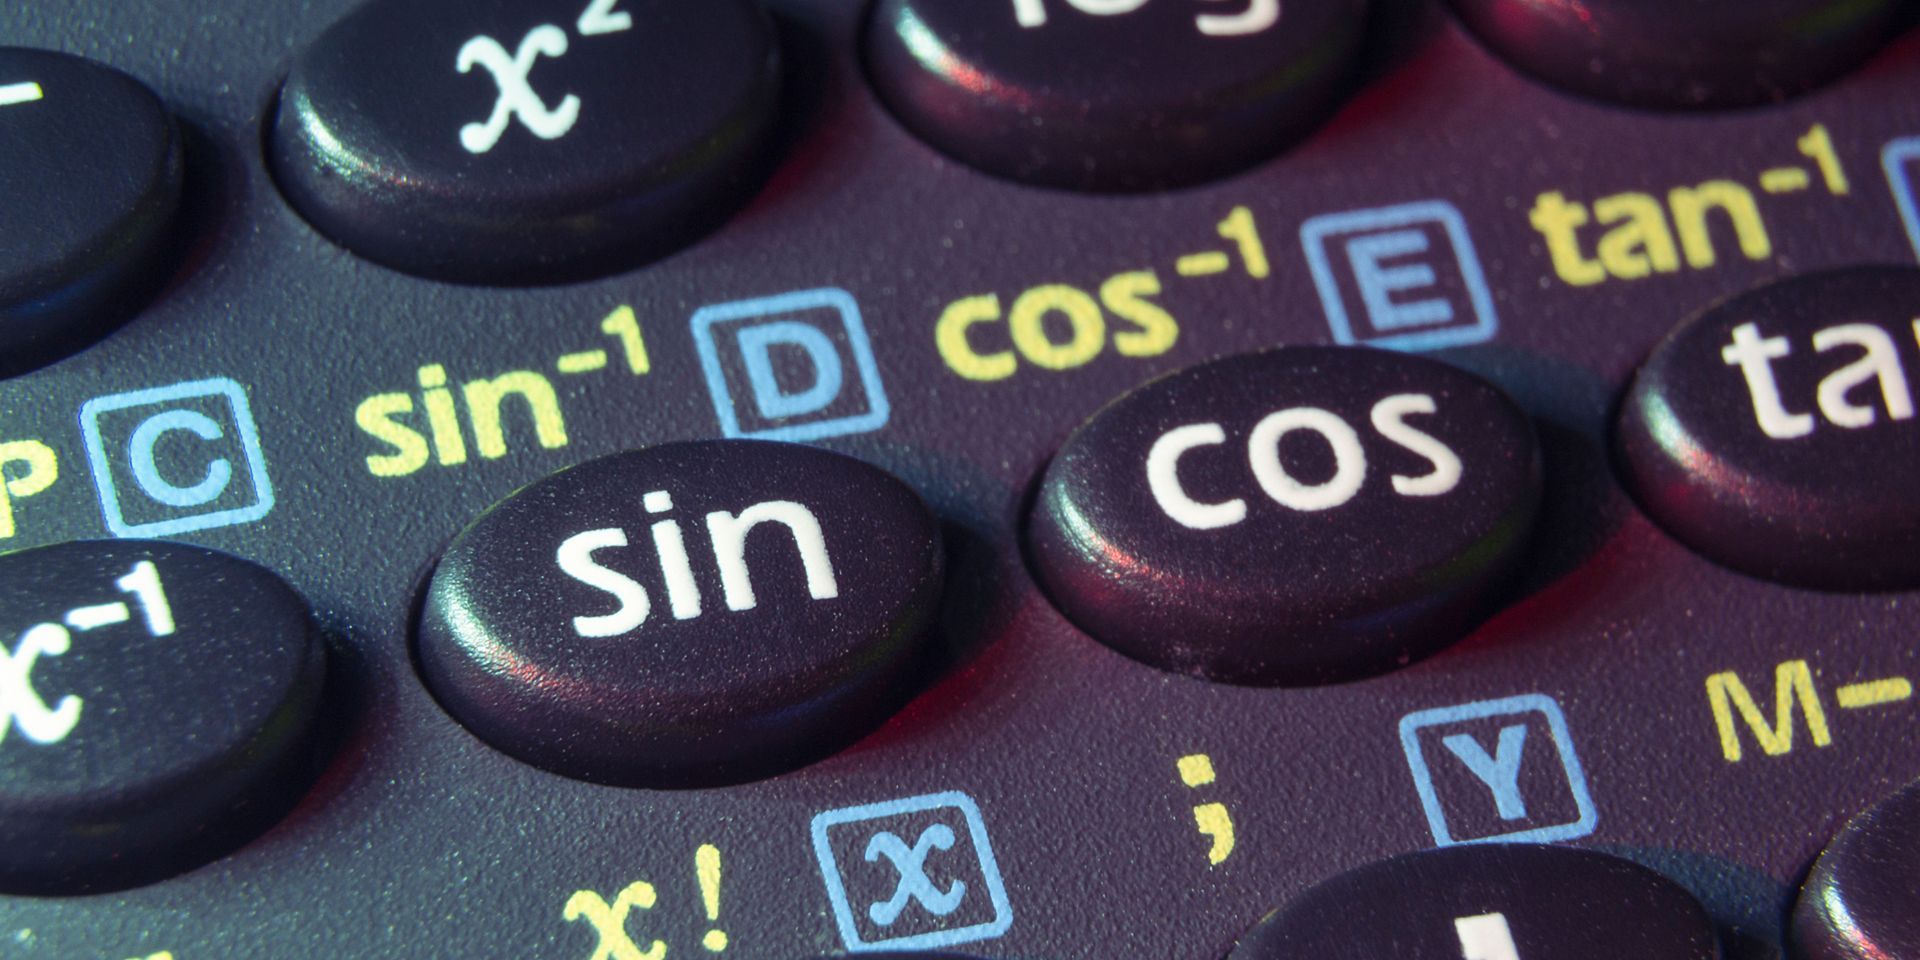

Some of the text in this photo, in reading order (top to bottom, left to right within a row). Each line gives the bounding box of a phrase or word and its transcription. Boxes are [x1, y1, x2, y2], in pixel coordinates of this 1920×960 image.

[1347, 229, 1454, 332] E
[736, 320, 844, 421] D
[1720, 318, 1920, 440] ta
[128, 409, 232, 507] C
[1145, 392, 1463, 531] cos
[554, 490, 839, 639] sin
[1442, 722, 1529, 822] Y
